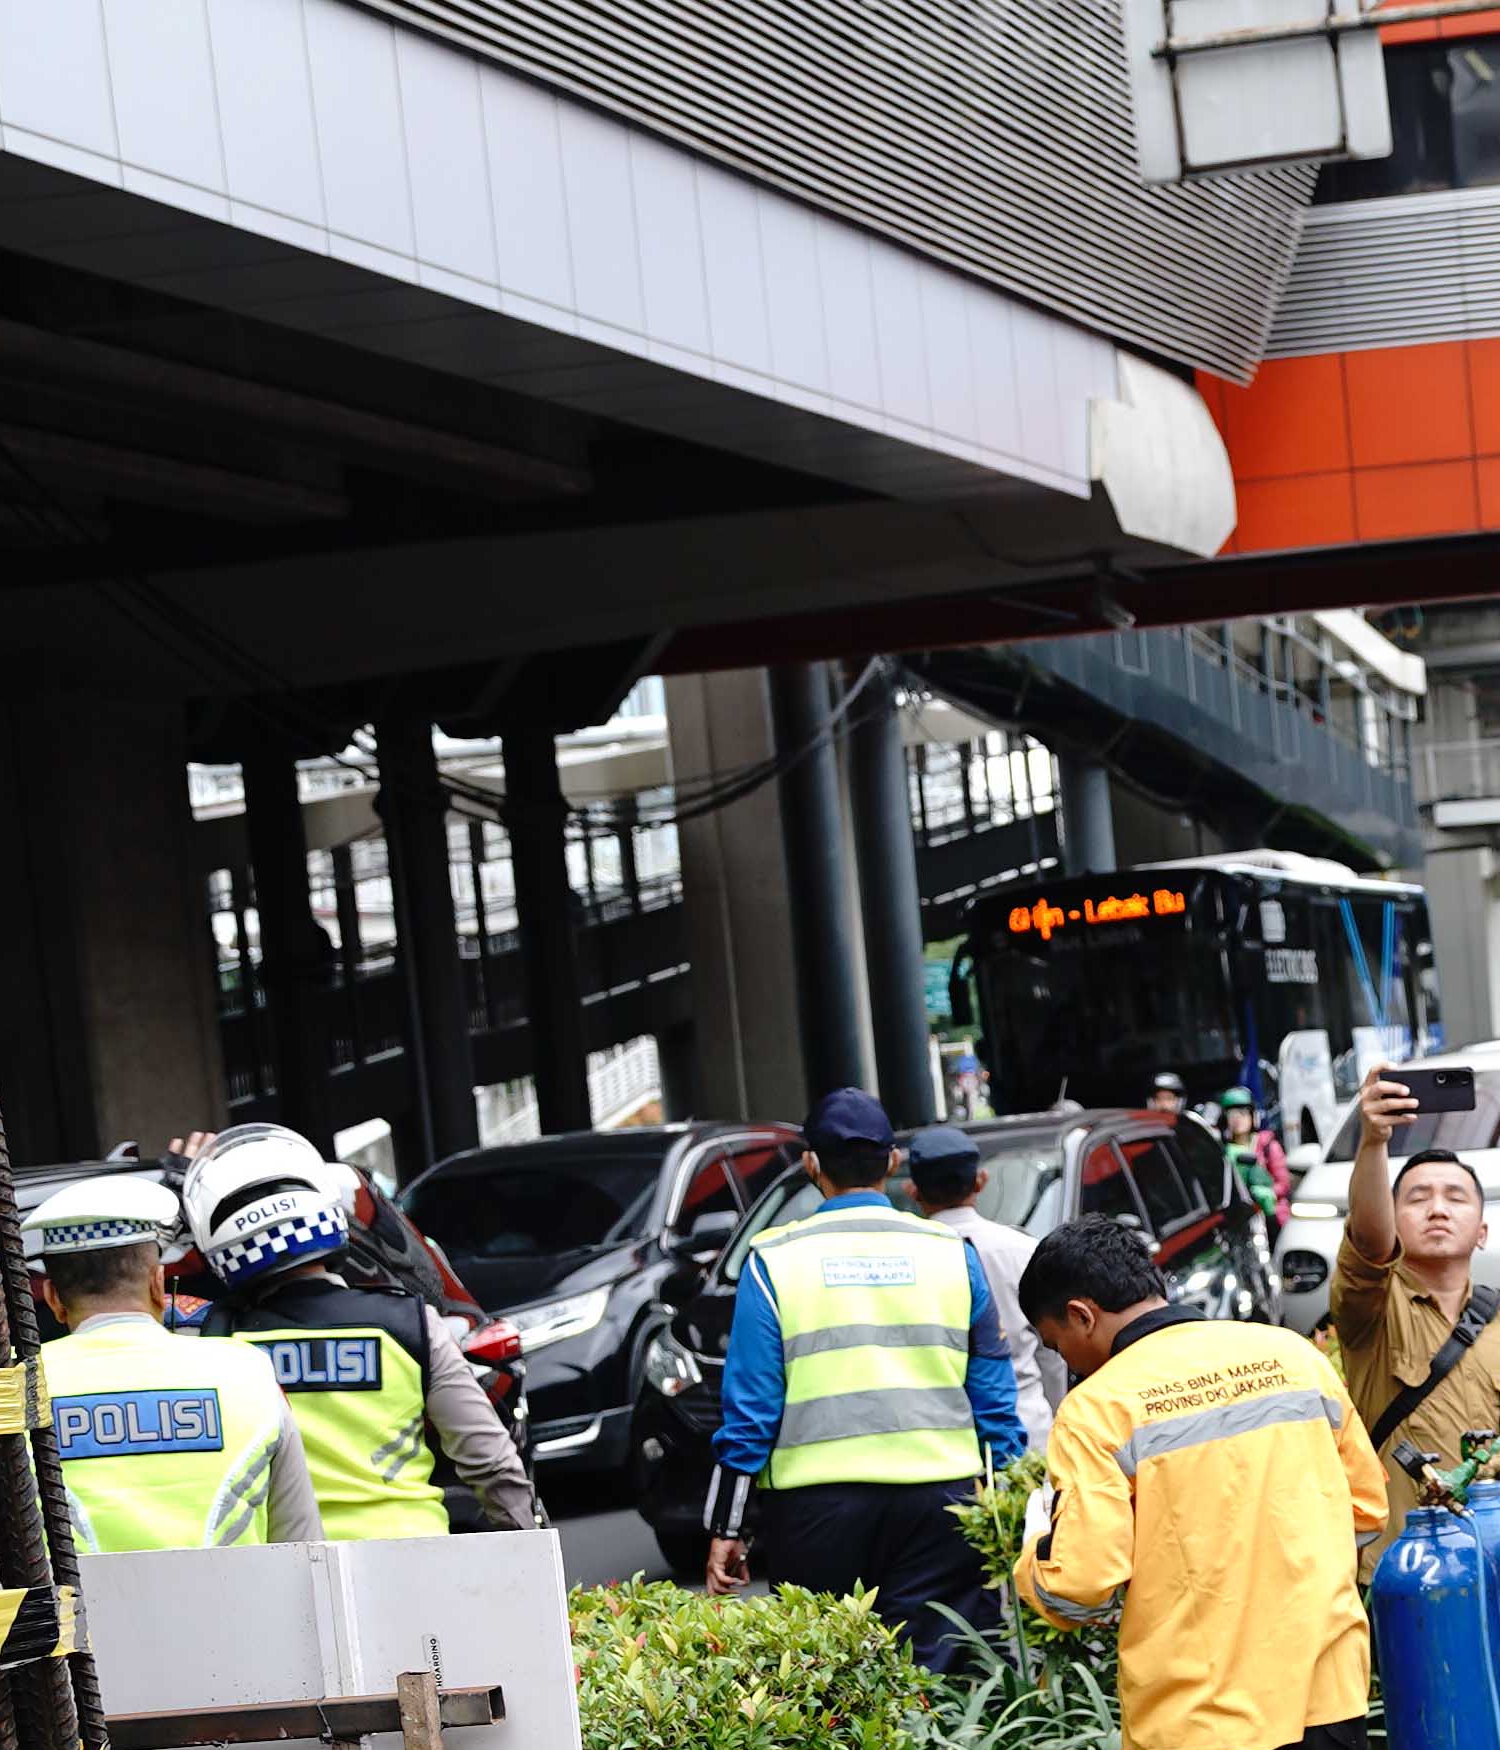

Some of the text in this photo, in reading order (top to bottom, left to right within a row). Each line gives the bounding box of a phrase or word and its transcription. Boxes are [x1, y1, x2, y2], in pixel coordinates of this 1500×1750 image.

[235, 1196, 298, 1232] POLISI
[259, 1340, 378, 1386] OLISI
[1138, 1358, 1284, 1401] DINAS BINA MARGA
[1145, 1373, 1290, 1416] PROVINSI DKI JAKARTA
[57, 1398, 220, 1449] POLISI
[429, 1637, 443, 1688] HOARDING
